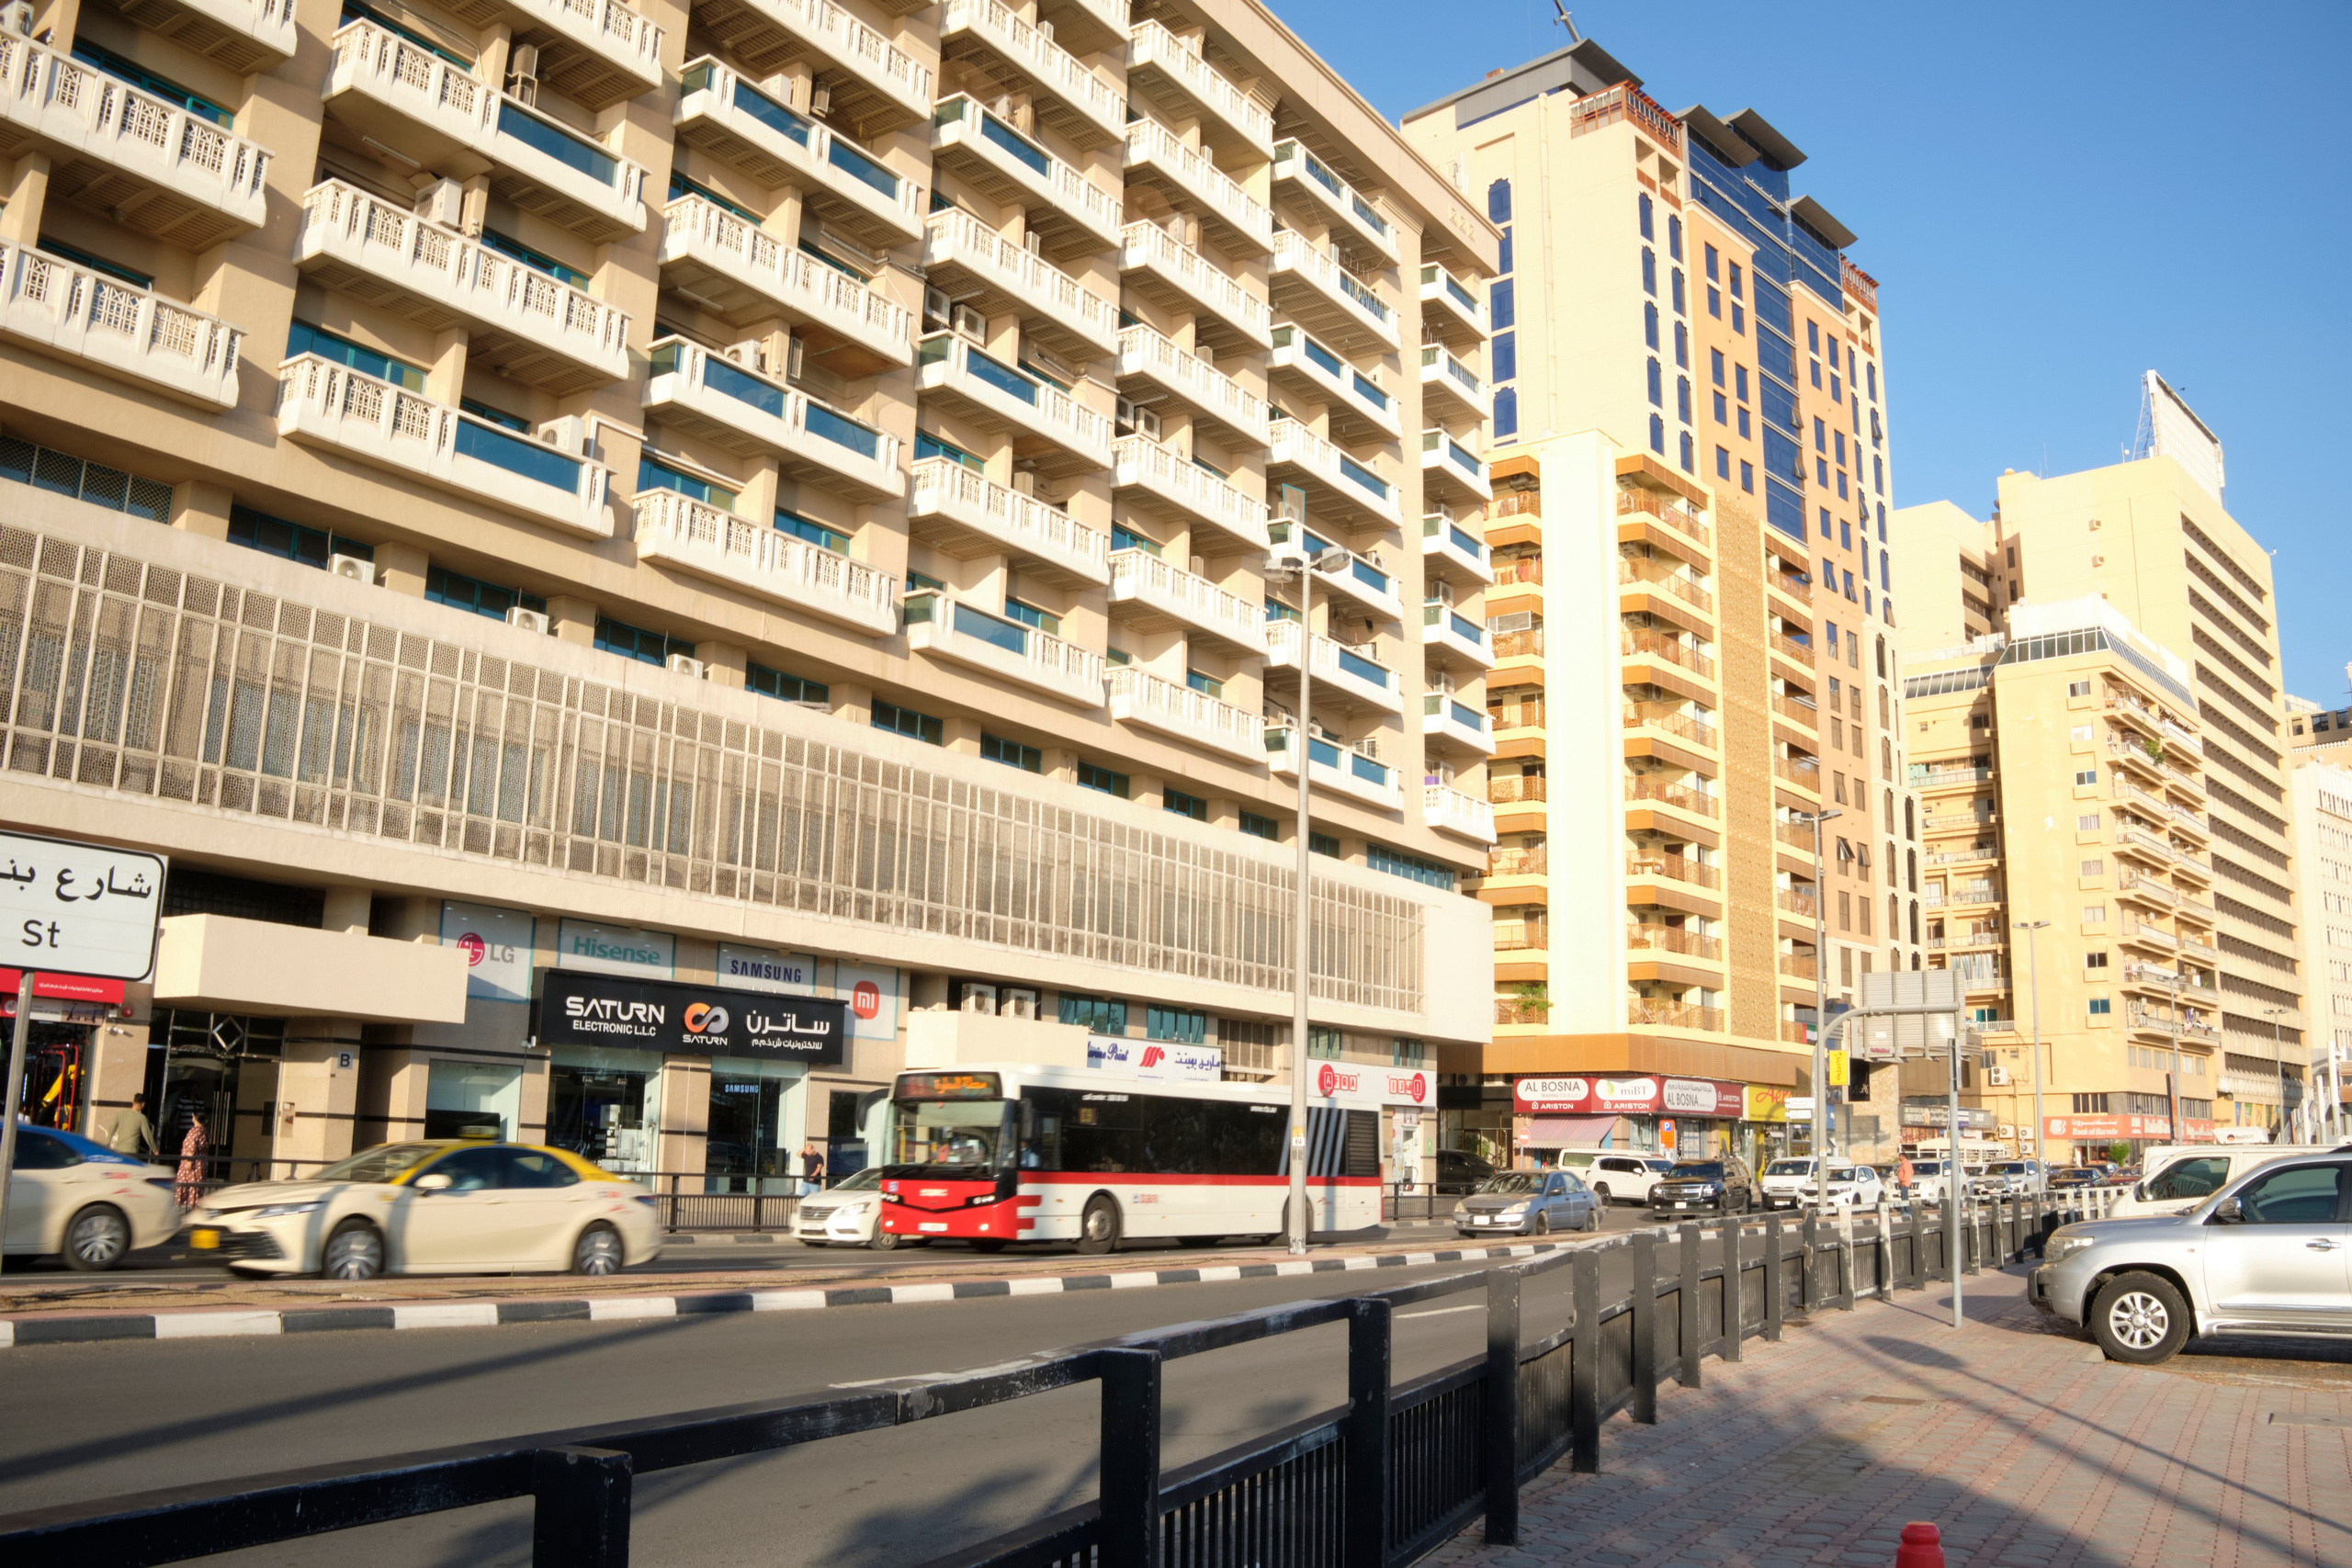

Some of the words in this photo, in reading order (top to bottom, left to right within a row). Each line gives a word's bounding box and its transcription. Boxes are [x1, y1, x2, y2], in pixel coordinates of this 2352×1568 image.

[55, 865, 152, 902] شارع
[21, 919, 61, 948] St
[490, 942, 514, 964] LG
[572, 935, 661, 965] Hisense
[730, 959, 801, 983] SAMSUNG
[565, 996, 664, 1024] SATURN
[572, 1020, 632, 1035] ELECTRONIC
[634, 1026, 656, 1036] L.L.C
[746, 1010, 831, 1035] ساترن
[682, 1034, 728, 1046] SATURN
[340, 1054, 350, 1066] B
[1107, 1043, 1129, 1061] Point
[724, 1083, 759, 1094] SAMSUNG
[1323, 1071, 1358, 1092] AFRA
[1525, 1081, 1537, 1092] AL
[1541, 1081, 1580, 1092] BOSNA
[1621, 1086, 1648, 1095] miBT
[1723, 1094, 1740, 1102] ARISTON
[1667, 1092, 1675, 1105] AL
[1676, 1093, 1699, 1107] BOSNA
[1664, 1122, 1670, 1131] P
